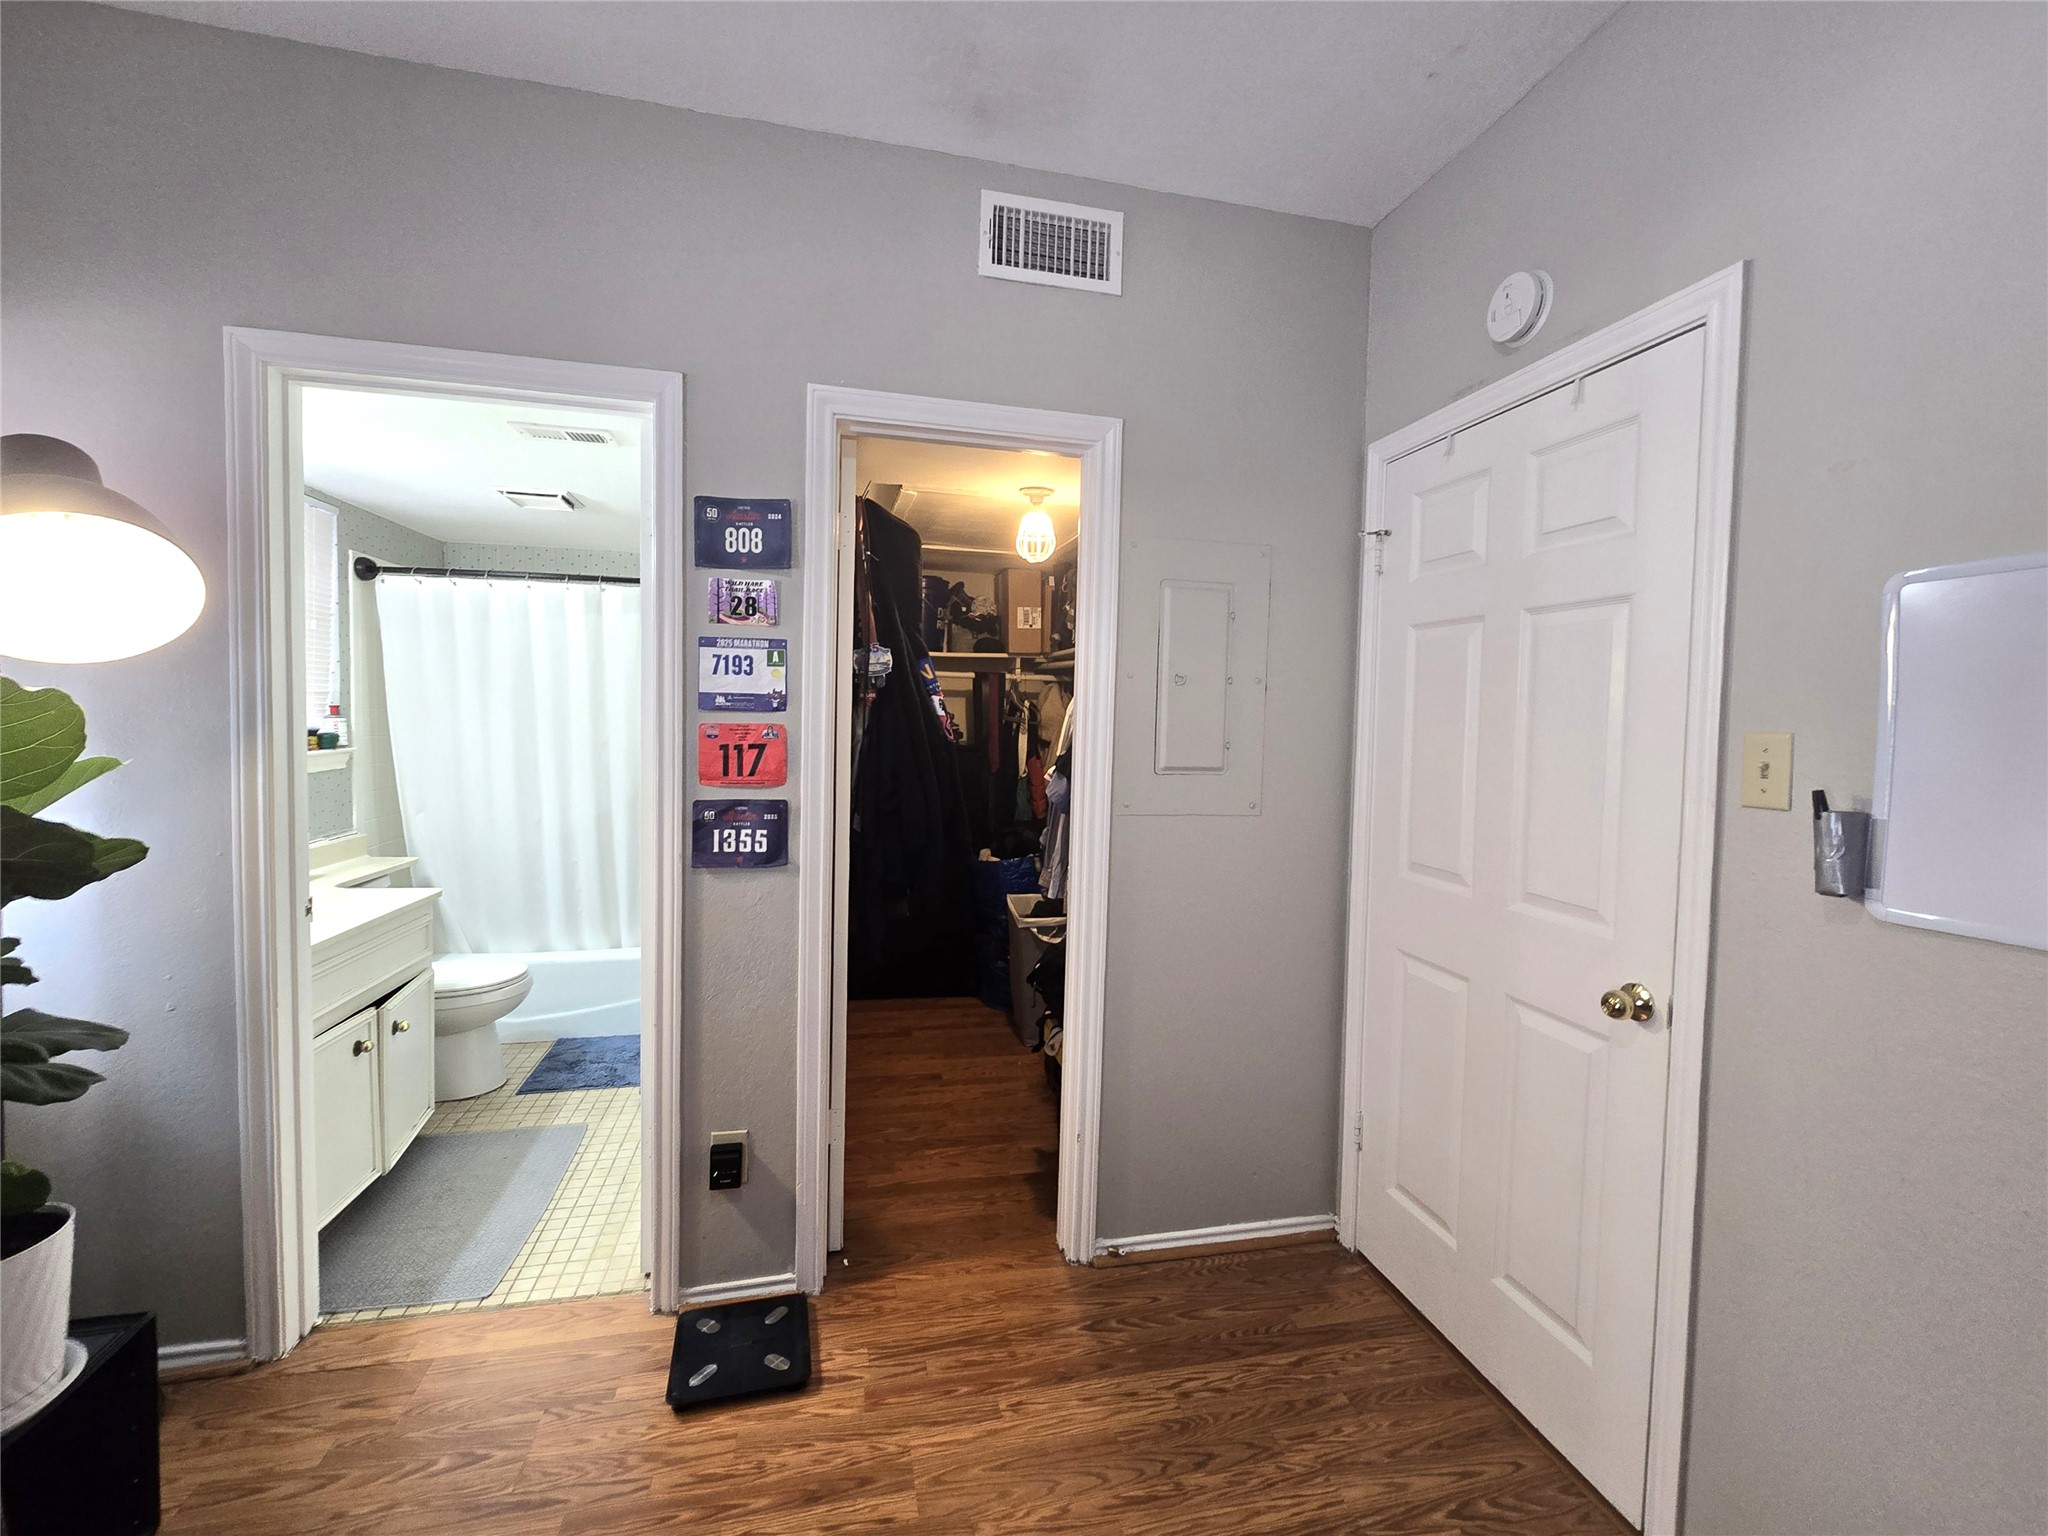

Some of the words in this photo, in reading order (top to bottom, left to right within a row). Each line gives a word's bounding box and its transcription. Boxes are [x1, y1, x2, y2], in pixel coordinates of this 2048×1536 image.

[706, 507, 718, 518] 50
[725, 527, 763, 554] 808
[730, 596, 757, 617] 28
[716, 638, 733, 648] 2025
[733, 639, 770, 649] MARATHON
[712, 654, 754, 676] 7193
[772, 650, 779, 663] A
[719, 743, 768, 777] 117
[712, 828, 768, 853] 1355
